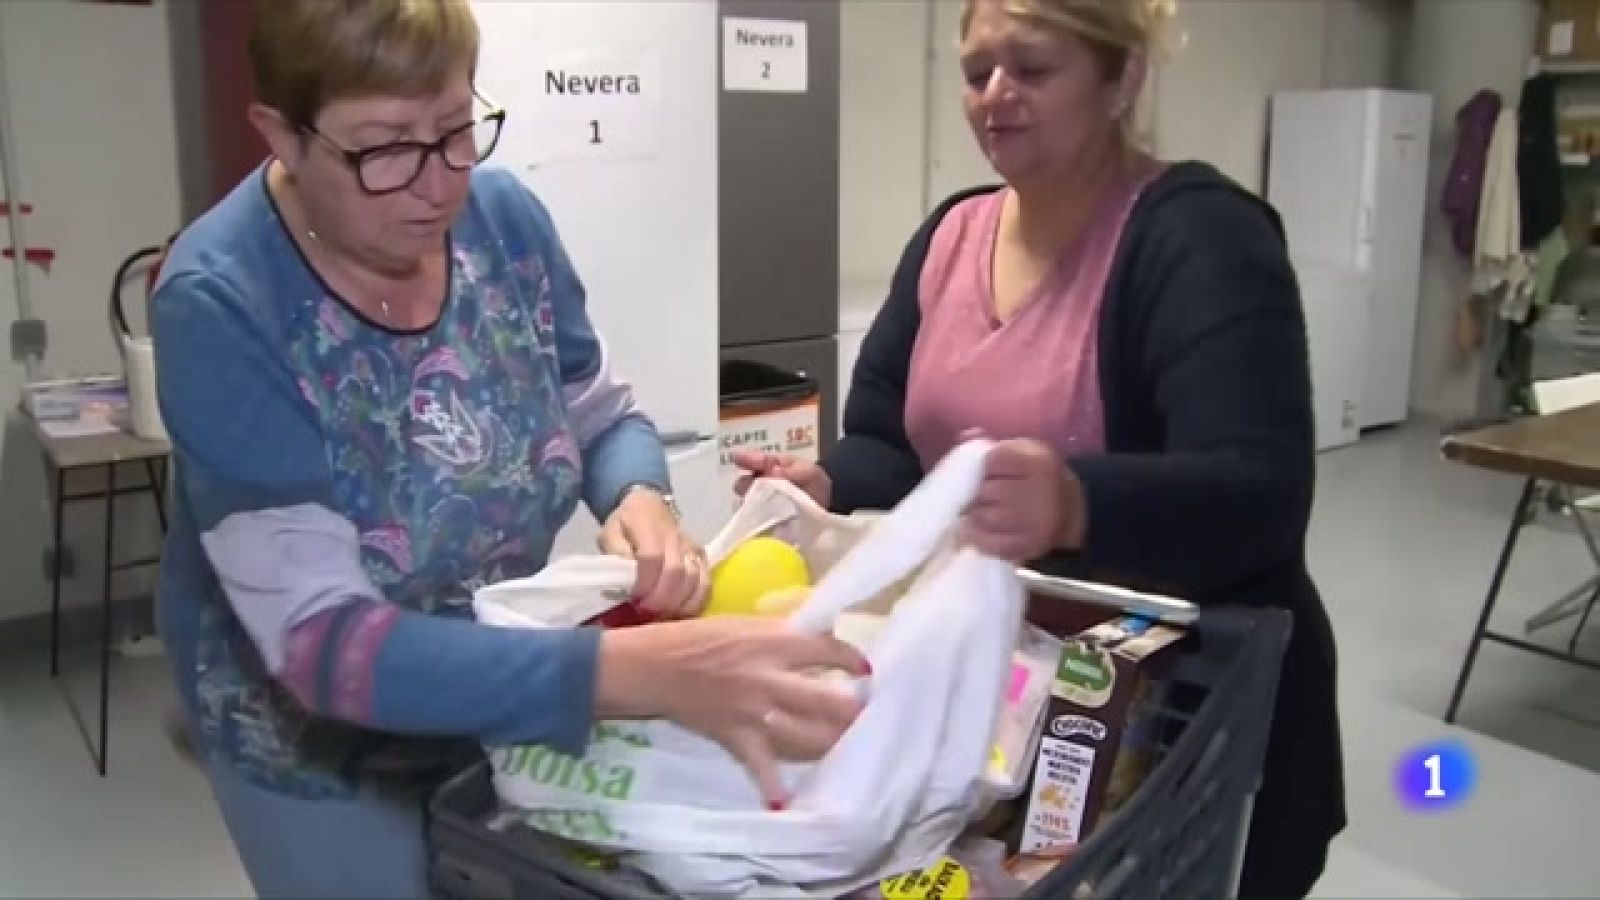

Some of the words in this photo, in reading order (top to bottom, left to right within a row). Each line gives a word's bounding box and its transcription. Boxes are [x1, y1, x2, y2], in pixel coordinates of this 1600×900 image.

[736, 29, 794, 47] Nevera
[762, 61, 771, 79] 2
[545, 70, 640, 95] Nevera
[589, 120, 602, 144] 1
